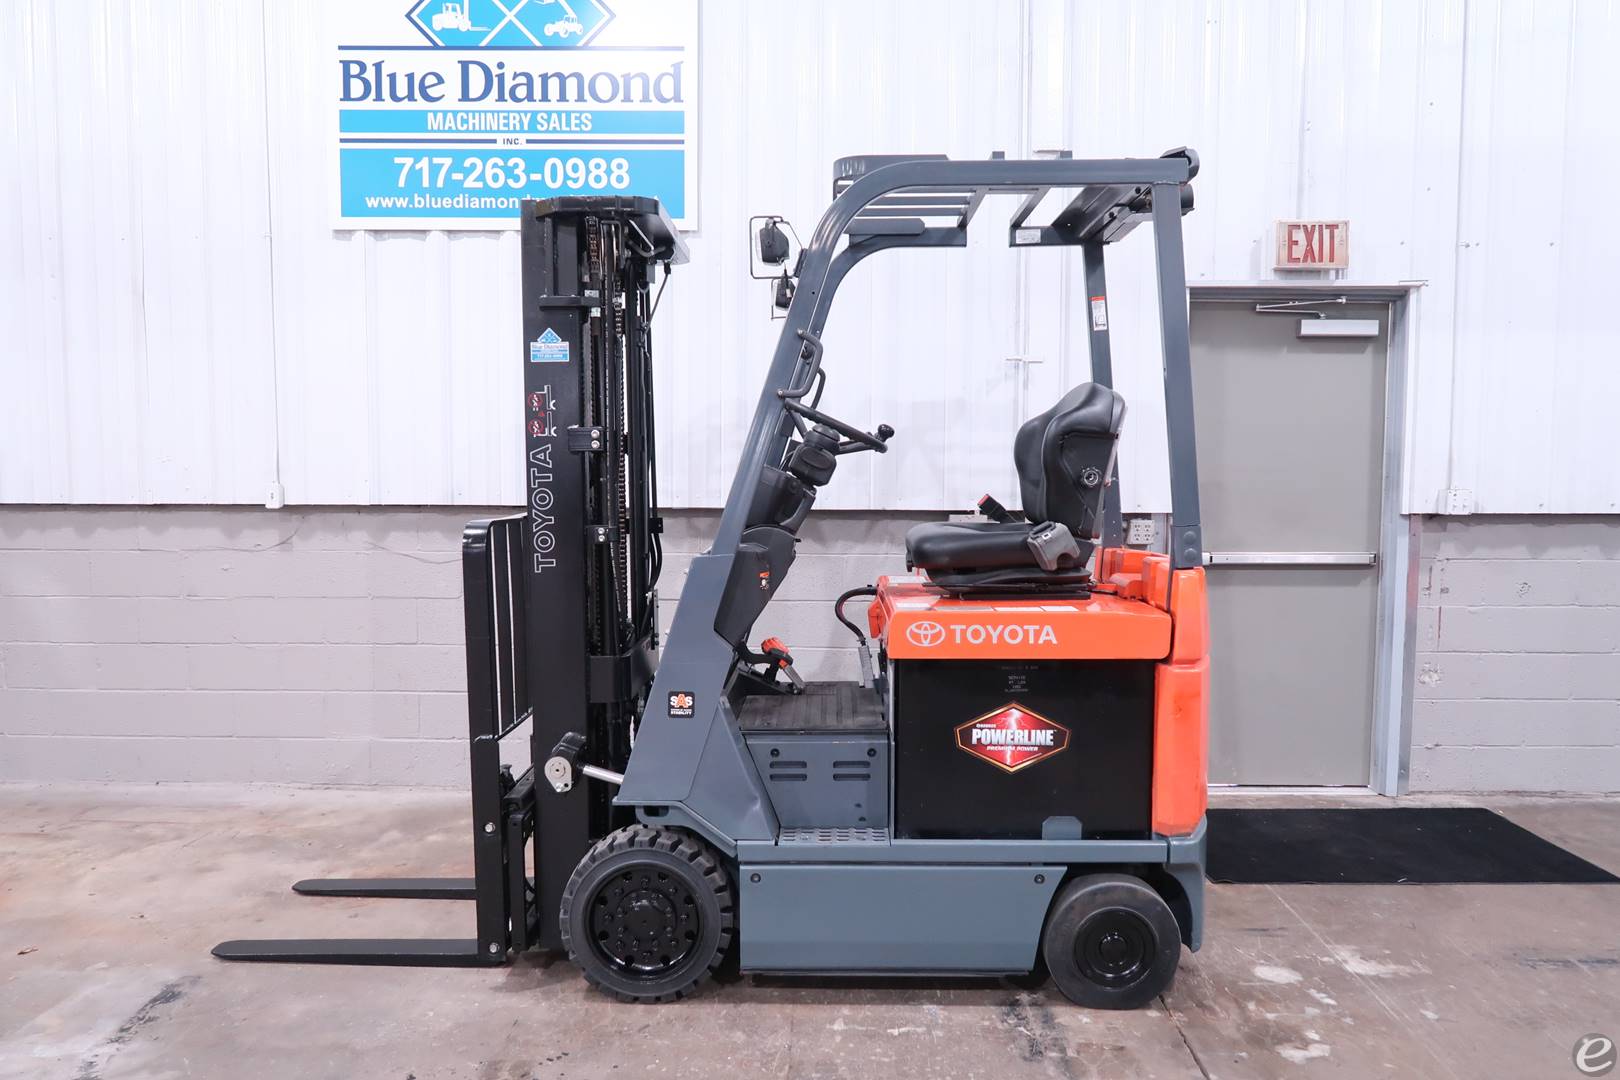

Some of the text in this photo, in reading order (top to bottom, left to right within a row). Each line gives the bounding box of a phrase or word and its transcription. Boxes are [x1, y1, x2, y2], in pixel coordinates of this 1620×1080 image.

[339, 59, 685, 104] Blue Diamond
[426, 112, 593, 132] MACHINERY SALES
[502, 137, 523, 146] INC.
[393, 157, 631, 190] 717-263-0988
[1287, 224, 1339, 264] EXIT
[530, 444, 556, 573] TOYOTA
[950, 624, 1058, 645] TOYOTA
[670, 693, 693, 708] SAS
[971, 728, 1055, 747] POWERLINE
